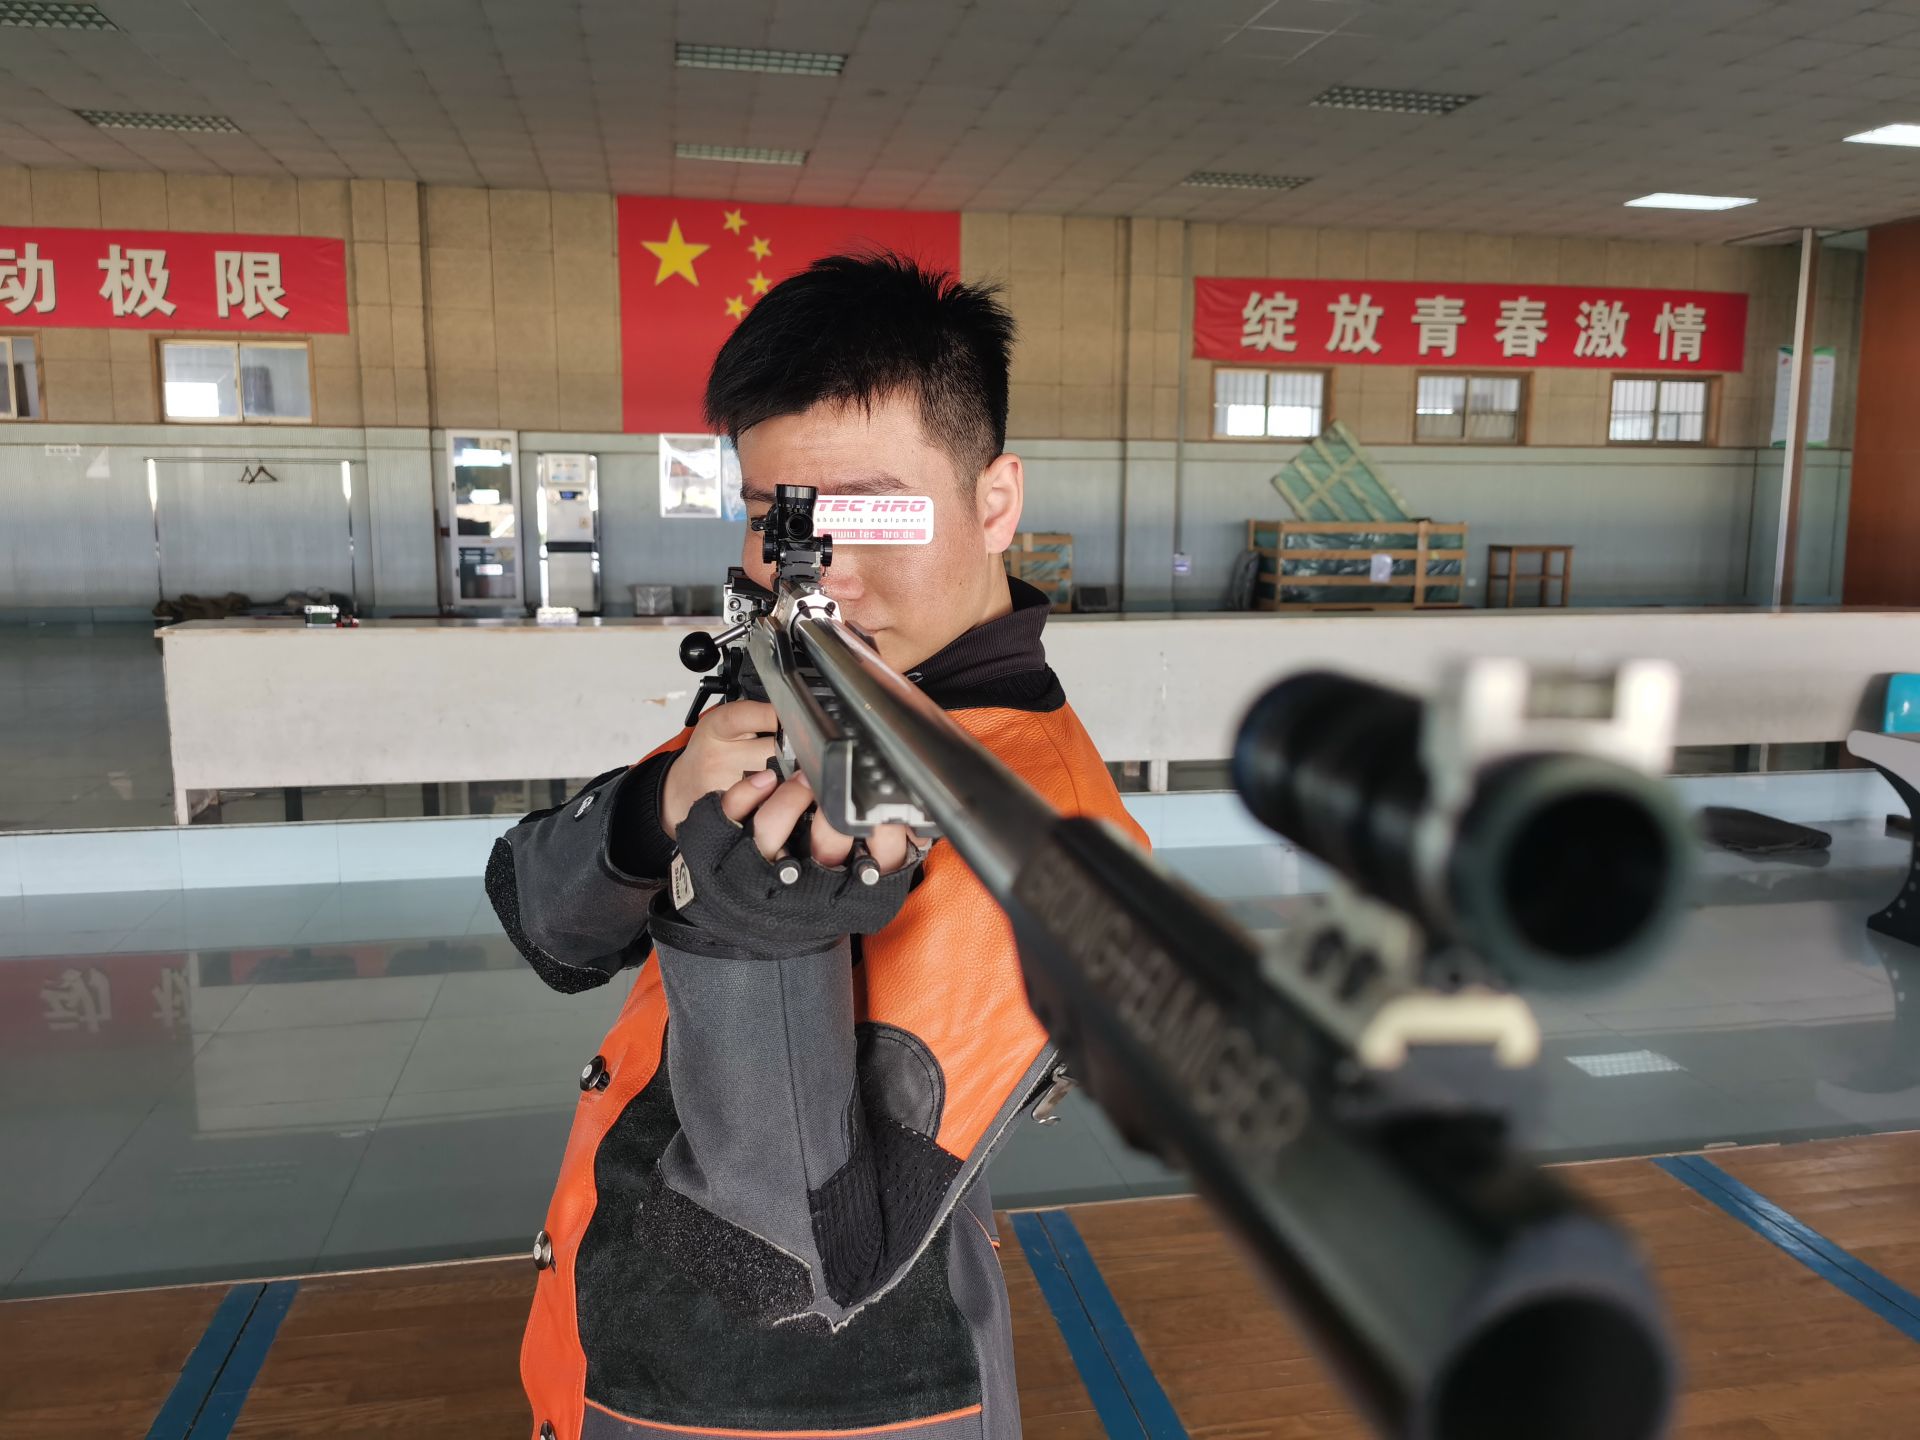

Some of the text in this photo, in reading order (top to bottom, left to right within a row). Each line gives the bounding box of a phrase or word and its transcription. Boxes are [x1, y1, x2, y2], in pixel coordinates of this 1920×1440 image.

[0, 242, 290, 319] 动极限
[1241, 291, 1707, 363] 绽放青春激情
